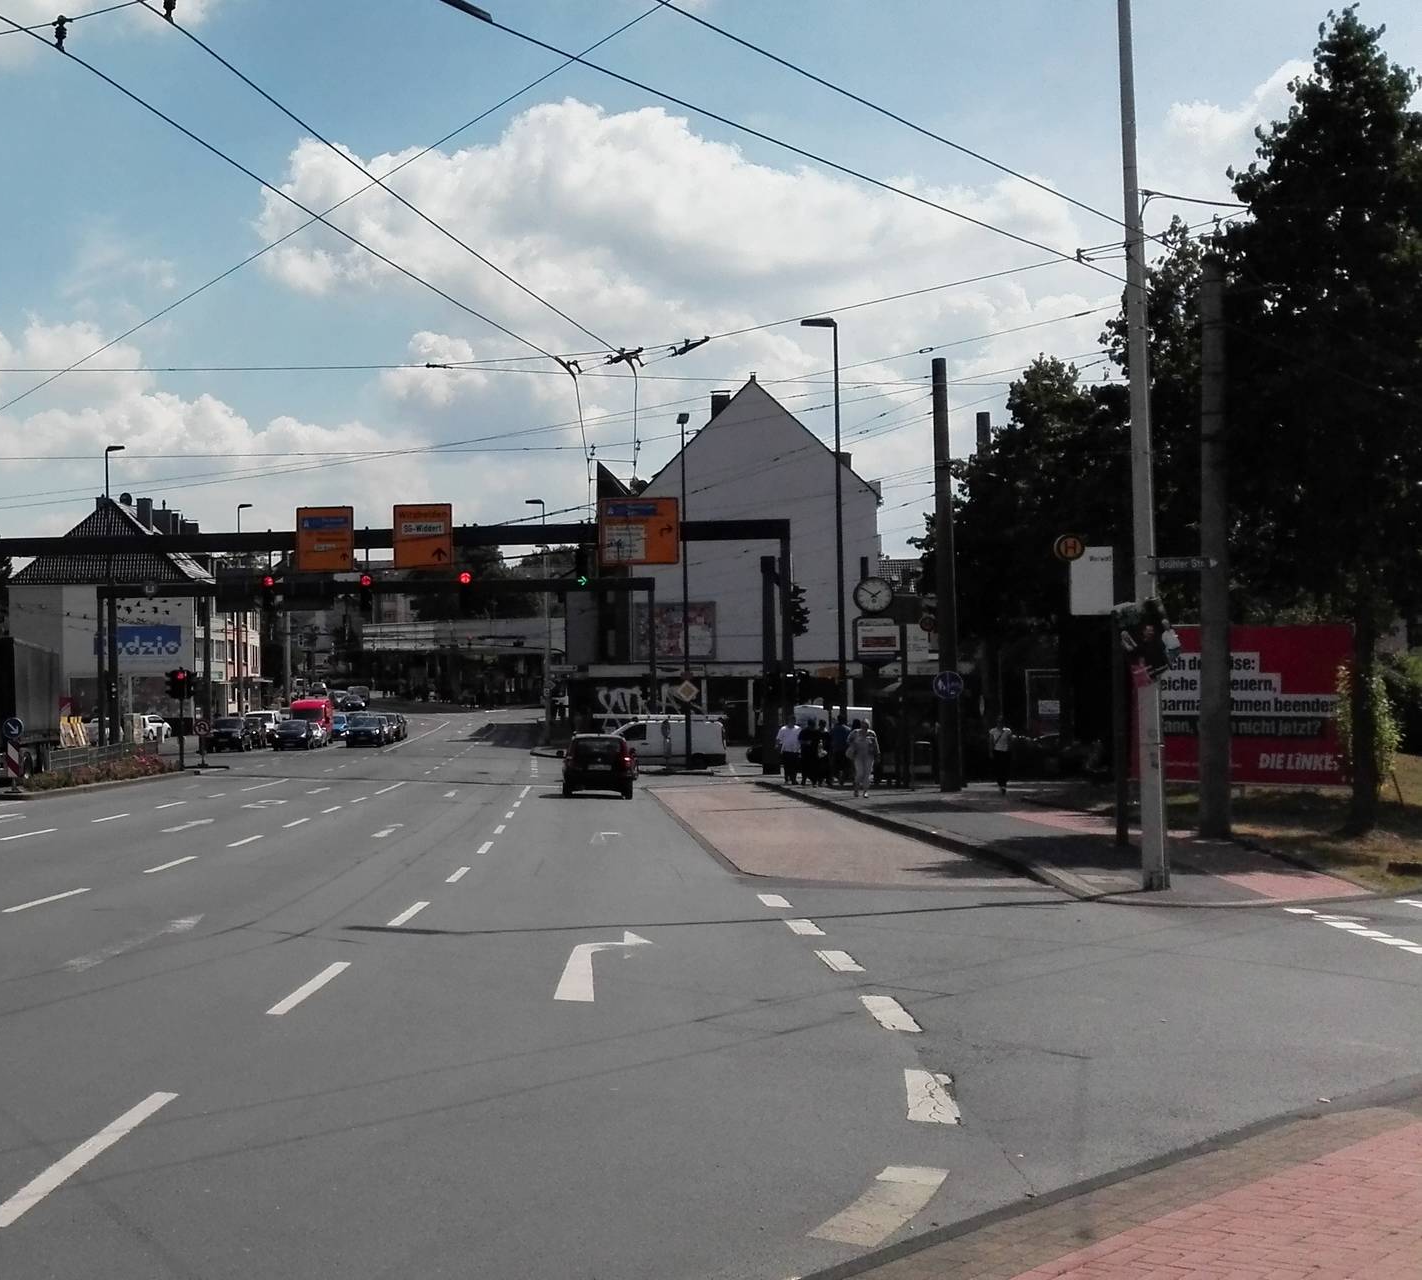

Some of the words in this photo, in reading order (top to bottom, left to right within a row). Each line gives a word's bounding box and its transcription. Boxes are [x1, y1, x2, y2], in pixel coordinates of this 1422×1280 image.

[1229, 657, 1256, 671] ise:
[1160, 678, 1198, 692] eiche
[1231, 678, 1277, 692] euern,
[1164, 722, 1194, 735] ann,
[1239, 720, 1277, 734] nicht
[1278, 720, 1322, 736] jetzt?
[1258, 752, 1285, 770] DIE
